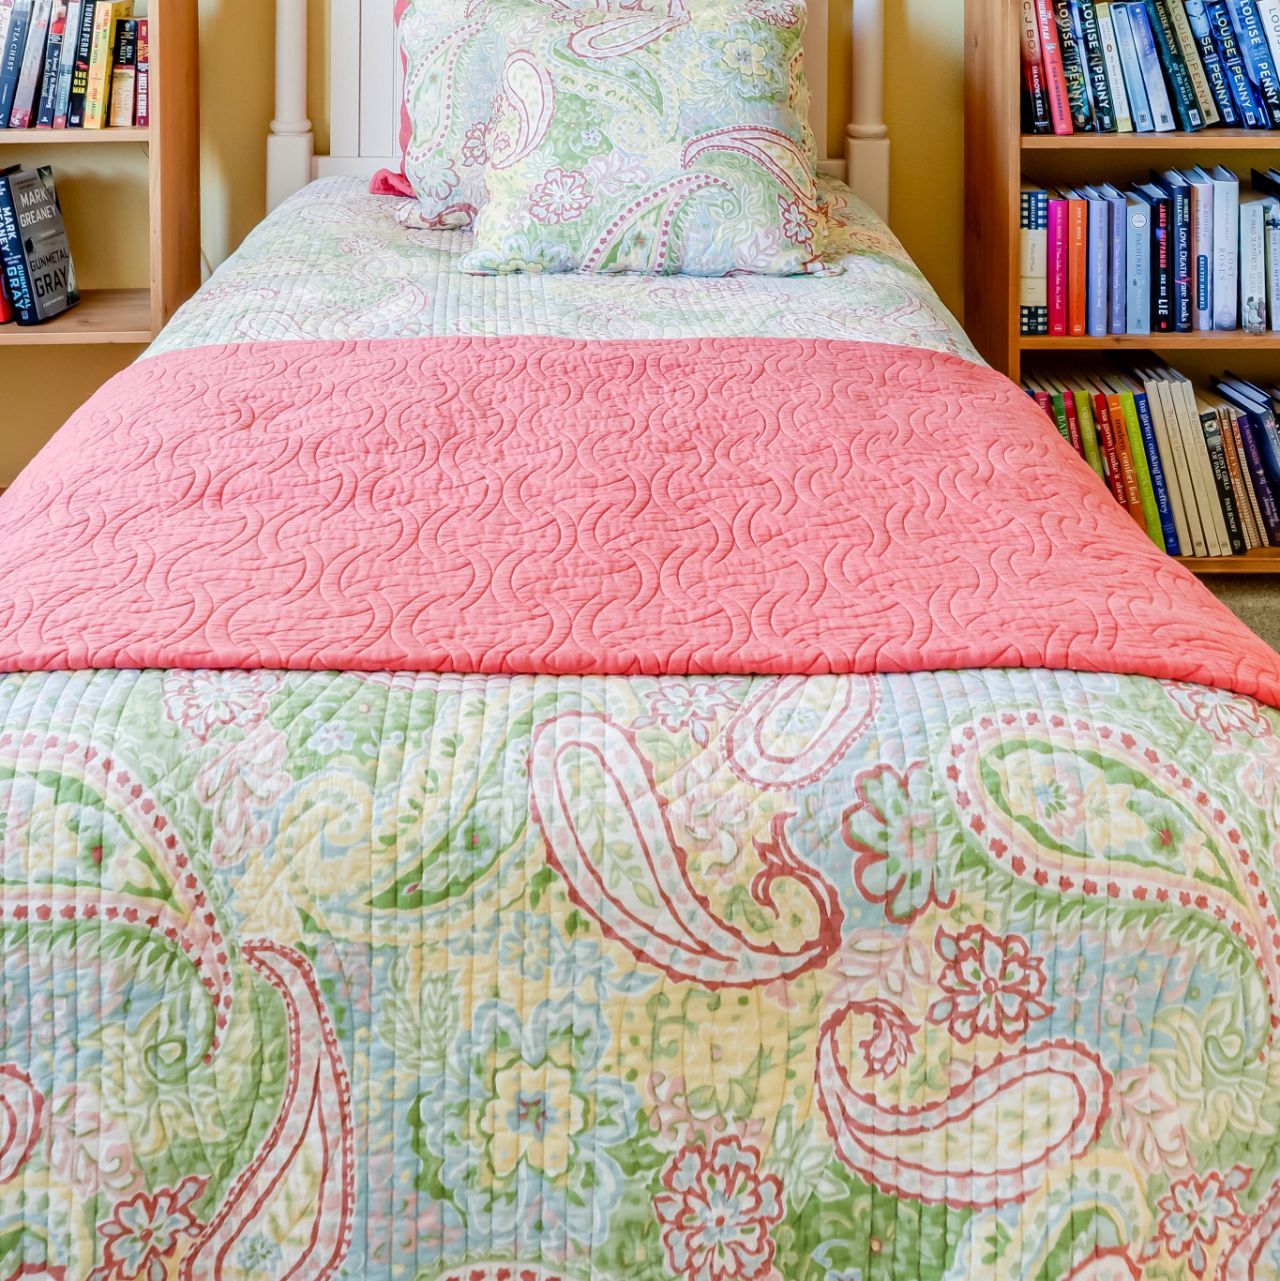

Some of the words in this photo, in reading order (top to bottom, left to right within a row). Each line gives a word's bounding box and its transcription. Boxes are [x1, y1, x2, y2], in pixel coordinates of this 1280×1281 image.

[82, 3, 94, 33] THOMAS
[1155, 1, 1169, 30] LOUISE
[79, 34, 90, 58] PERRY
[1058, 2, 1074, 49] LOUISE
[1068, 66, 1085, 107] PENNY
[1082, 3, 1098, 49] LOUISE
[1093, 67, 1110, 109] PENNY
[1172, 6, 1192, 50] LOUISE
[1189, 63, 1209, 106] PENNY
[1215, 10, 1237, 58] LOUISE
[1231, 66, 1252, 108] PENNY
[1240, 0, 1261, 45] LOUISE
[1258, 63, 1279, 105] PENNY
[1209, 63, 1230, 106] PENNY
[20, 187, 48, 208] MARK
[2, 206, 17, 239] MARK
[19, 204, 56, 228] GREANEY
[30, 247, 69, 272] GUNMETAL
[7, 266, 25, 309] GRAY
[17, 264, 32, 309] GUNMETAL
[34, 266, 68, 298] GRAY
[1145, 442, 1160, 475] cooking
[1213, 460, 1222, 480] PARIS
